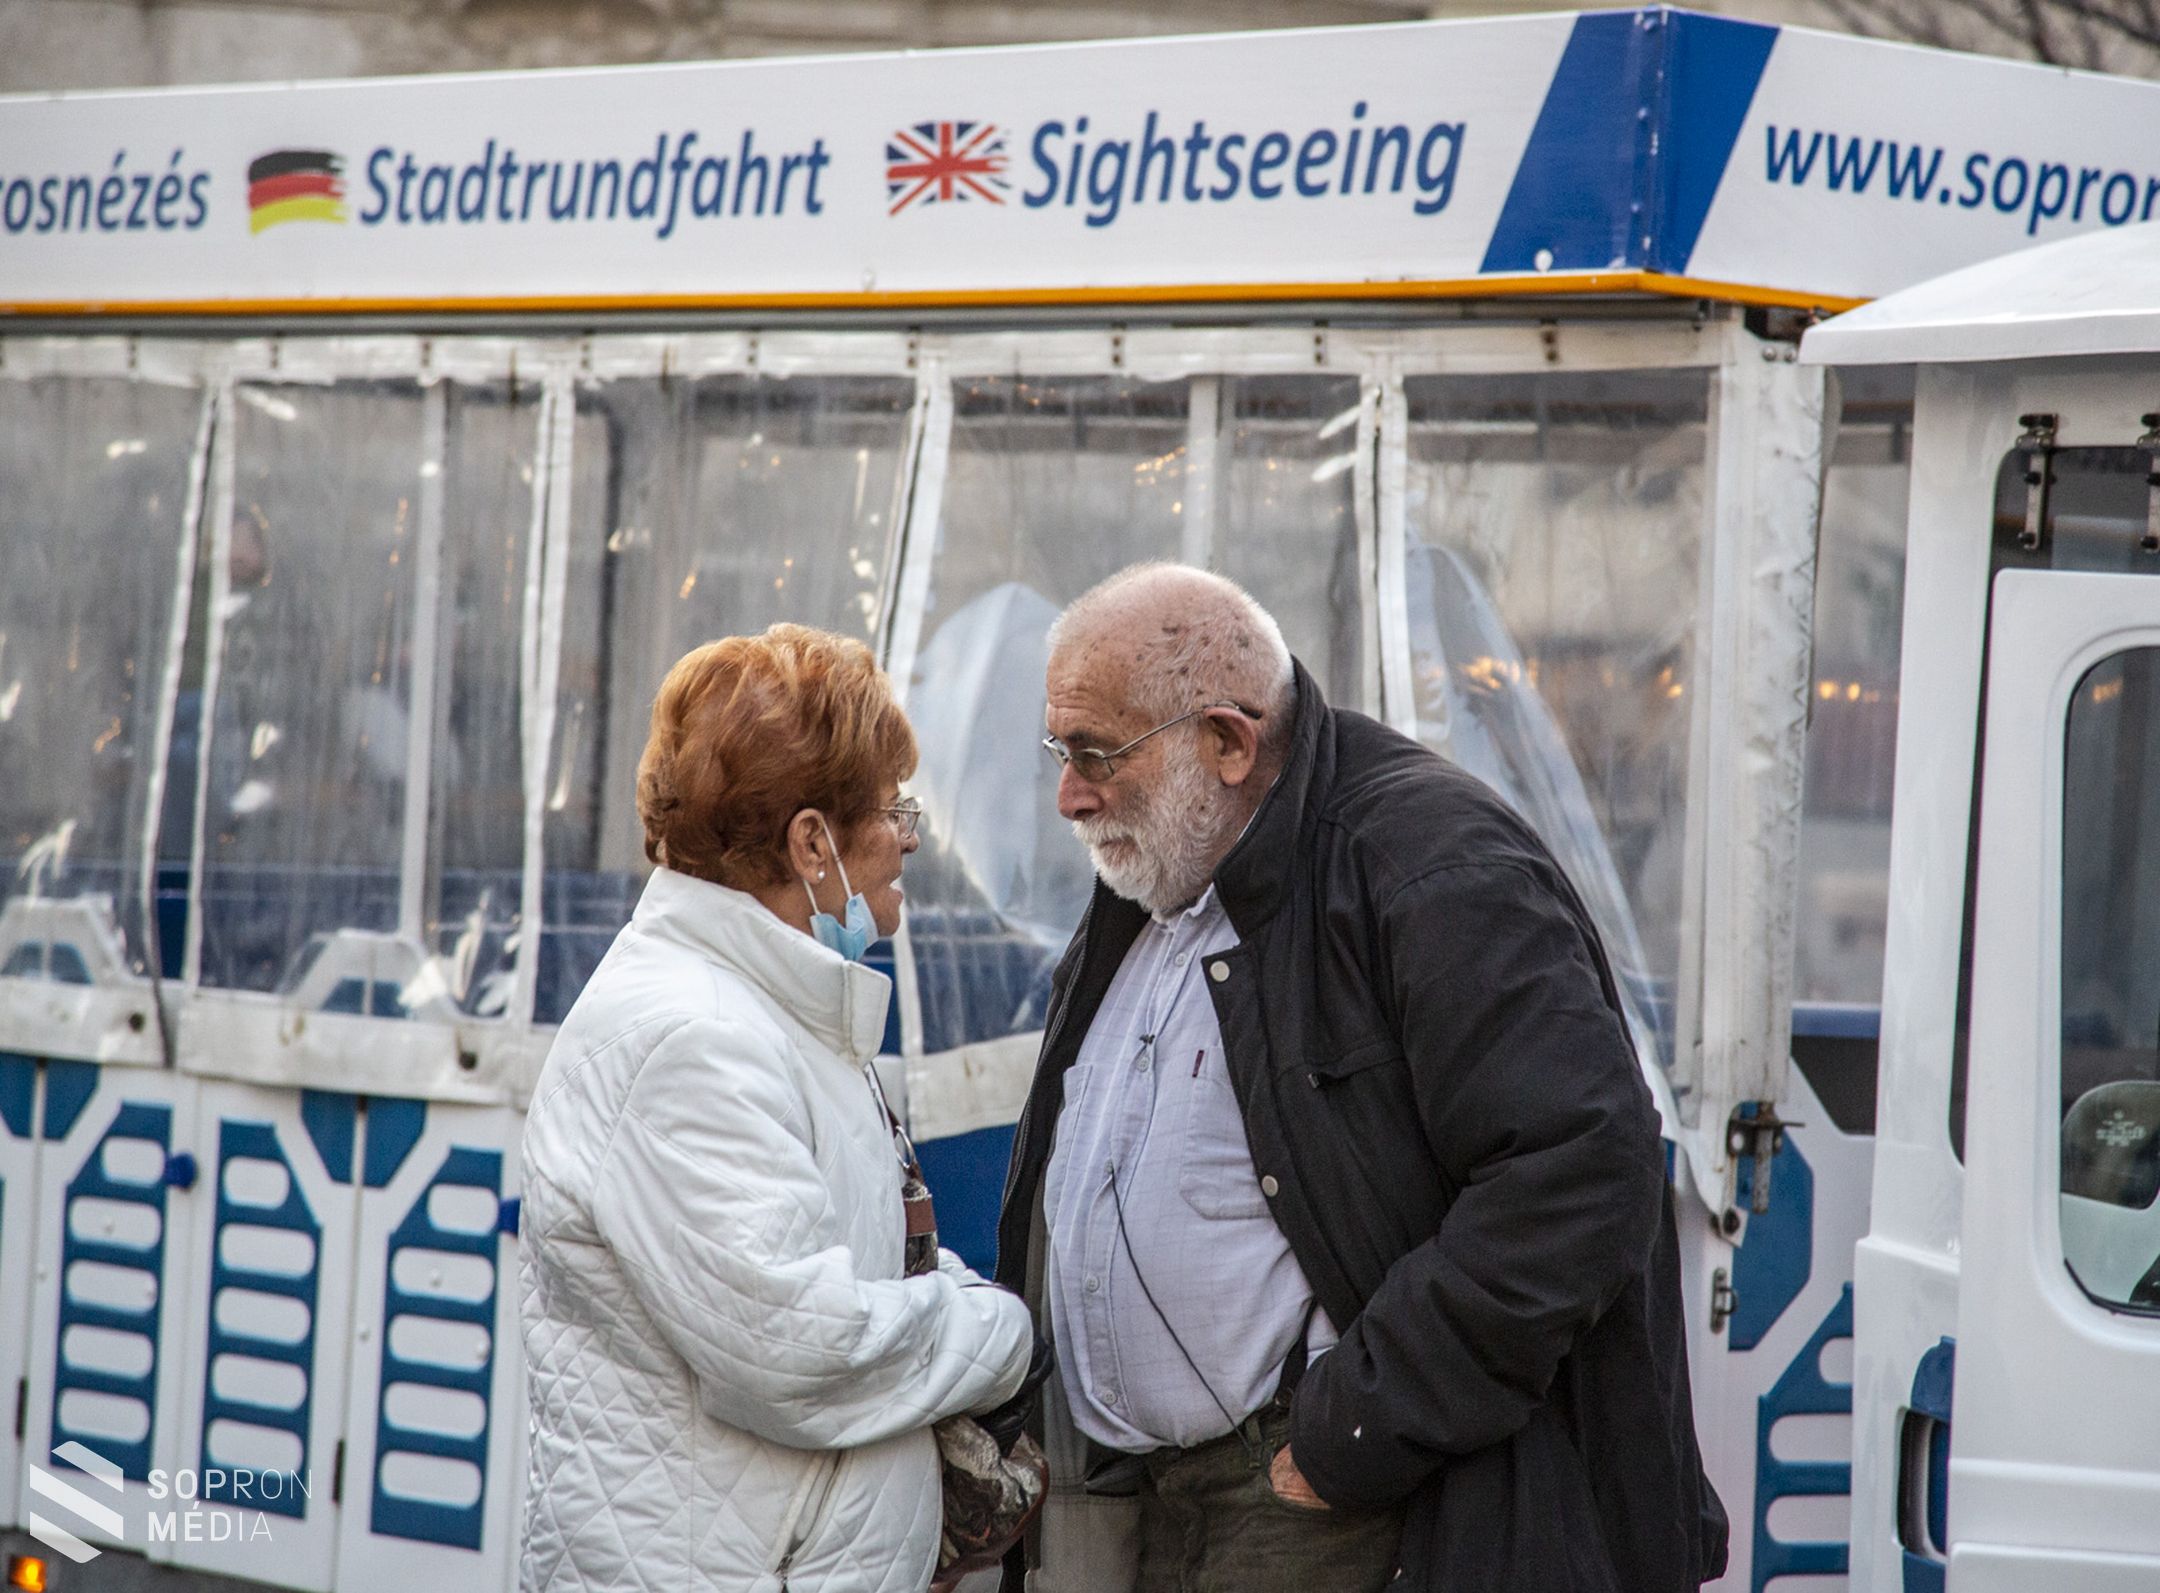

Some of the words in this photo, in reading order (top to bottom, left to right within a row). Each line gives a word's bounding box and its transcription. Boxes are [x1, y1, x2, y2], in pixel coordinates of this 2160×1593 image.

[0, 151, 209, 233] osnézés
[361, 131, 829, 239] Stadtrundfahrt
[1024, 102, 1465, 227] Sightseeing
